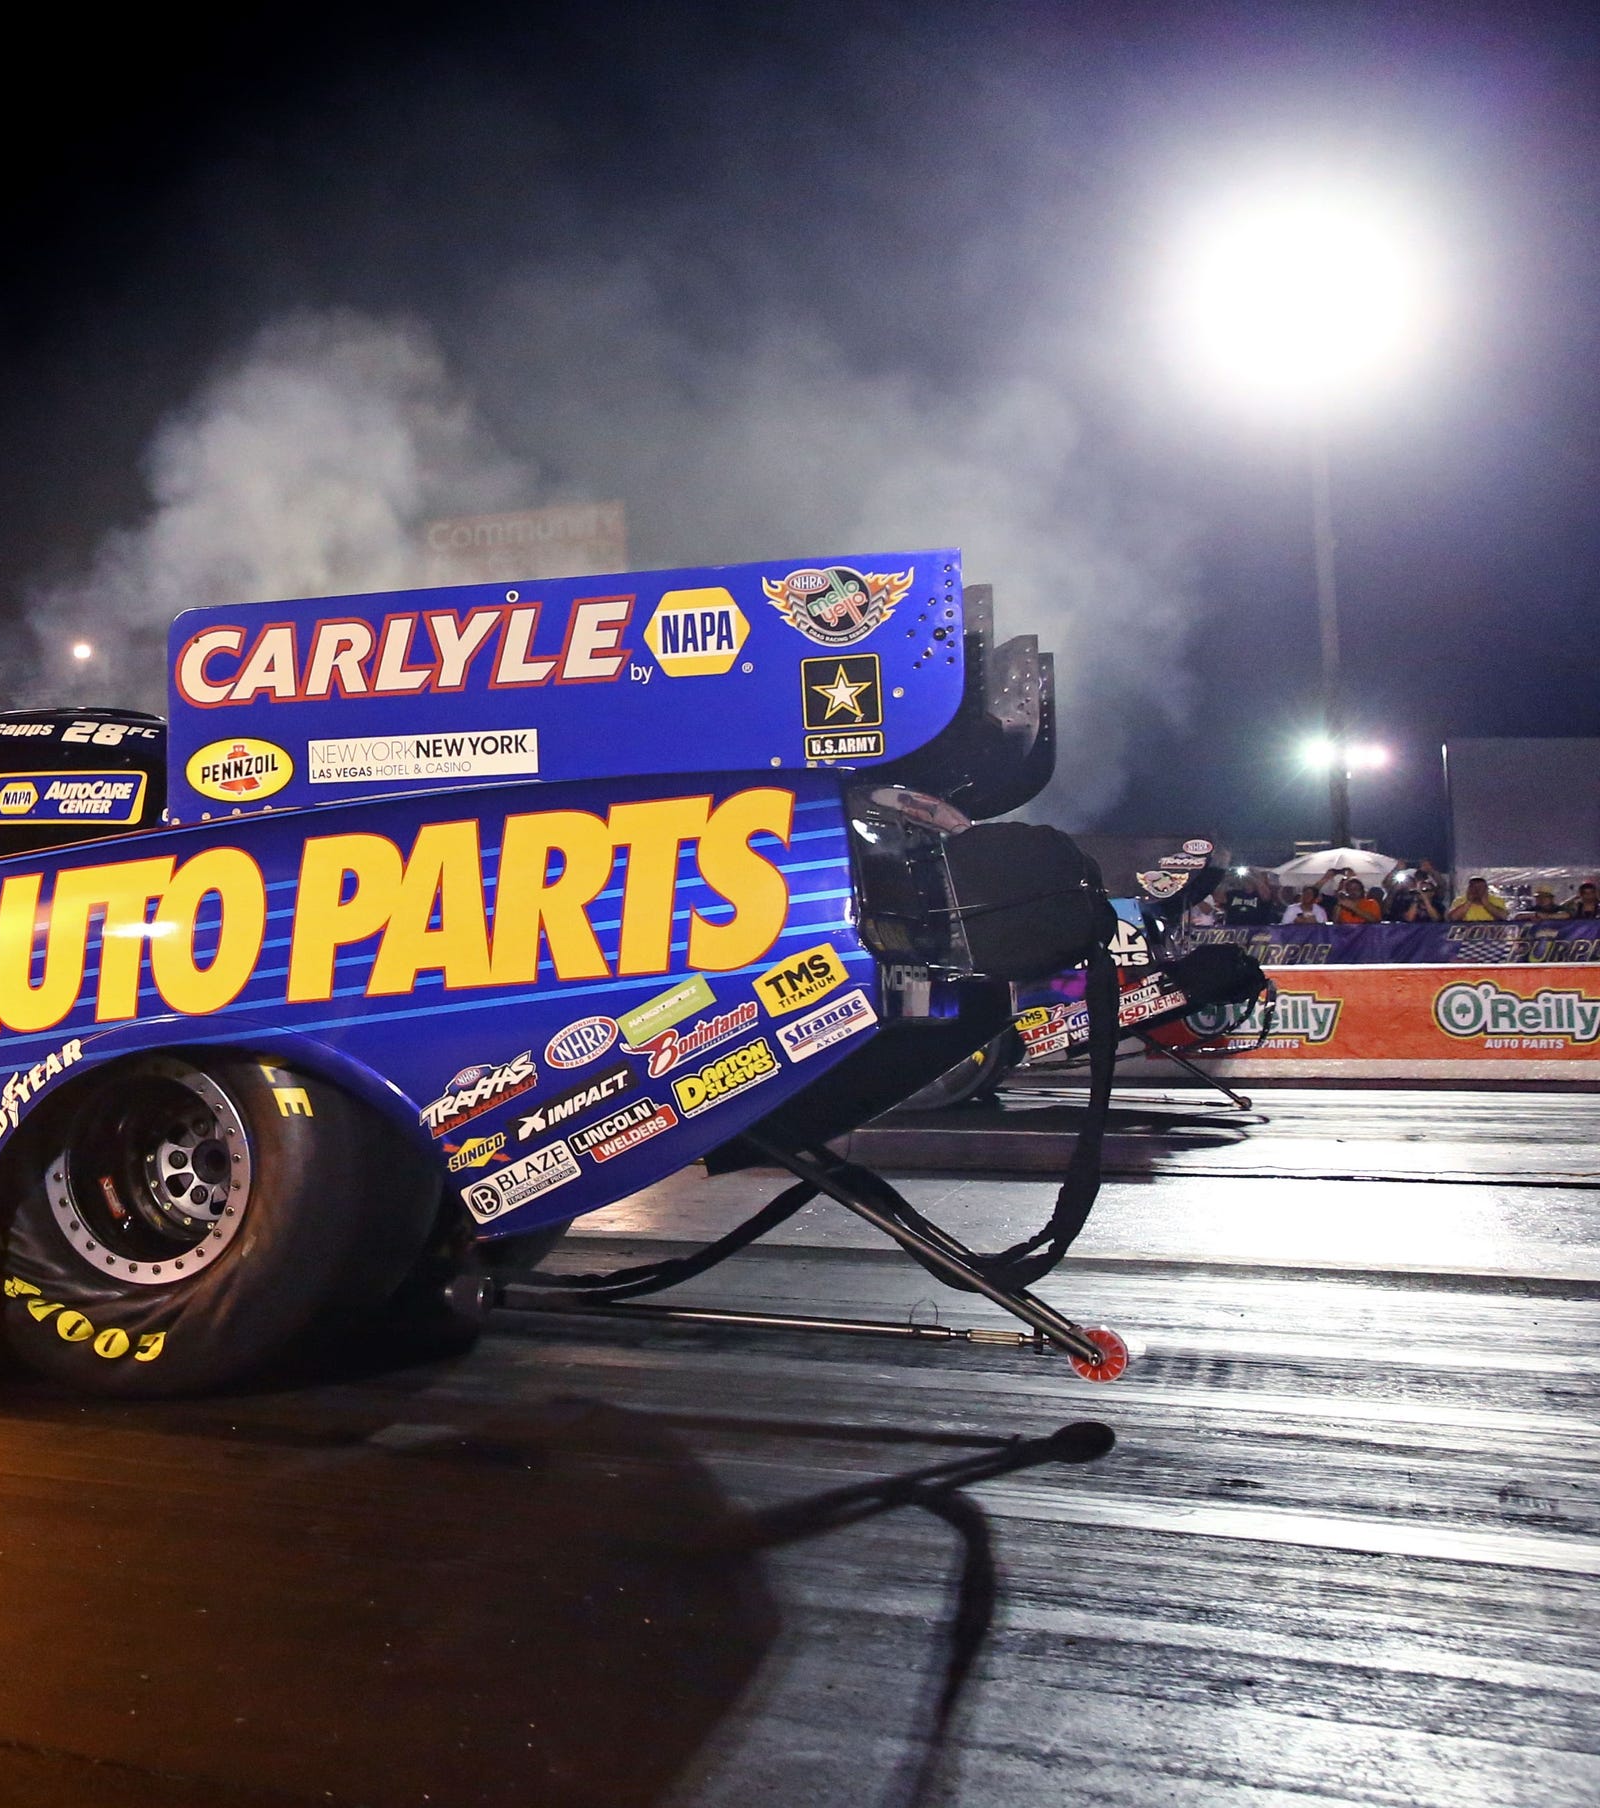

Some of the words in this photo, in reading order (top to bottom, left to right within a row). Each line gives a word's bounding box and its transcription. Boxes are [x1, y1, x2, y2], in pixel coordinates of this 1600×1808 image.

[792, 578, 823, 589] NHRA
[808, 571, 859, 617] mello
[661, 610, 735, 655] NAPA
[825, 634, 848, 643] RACING
[848, 625, 869, 640] SERIES
[176, 595, 635, 707] CARLYLE
[630, 663, 653, 684] by
[61, 720, 127, 746] 28
[127, 727, 160, 739] FC
[201, 752, 279, 785] PENNZOIL
[312, 768, 332, 779] LAS
[335, 766, 372, 778] VEGAS
[375, 764, 409, 776] HOTEL
[413, 763, 421, 775] &
[425, 761, 471, 773] CASINO
[2, 790, 33, 807] NAPA
[58, 799, 113, 815] CENTER
[287, 786, 797, 1002] PARTS
[1447, 923, 1533, 941] ROYAL
[765, 953, 831, 999] TMS
[779, 974, 837, 1009] TITANIUM
[784, 997, 864, 1047] Strange
[1442, 988, 1600, 1036] O'Reilly
[551, 1017, 599, 1046] CHAMPIONSHIP
[554, 1024, 611, 1063] NHRA
[816, 1027, 853, 1050] AXLES
[1021, 1019, 1065, 1042] ARP
[1484, 1038, 1519, 1049] AUTO
[1522, 1038, 1564, 1049] PARTS
[565, 1057, 586, 1069] DRAG
[587, 1036, 614, 1060] RACING
[421, 1053, 535, 1128] TRAXXAS
[456, 1068, 481, 1086] NHRA
[706, 1055, 775, 1098] SLEEVES
[573, 1100, 652, 1152] LINCOLN
[599, 1115, 668, 1156] WELDERS
[449, 1133, 504, 1171] SUNOCO
[495, 1145, 569, 1192] BLAZE
